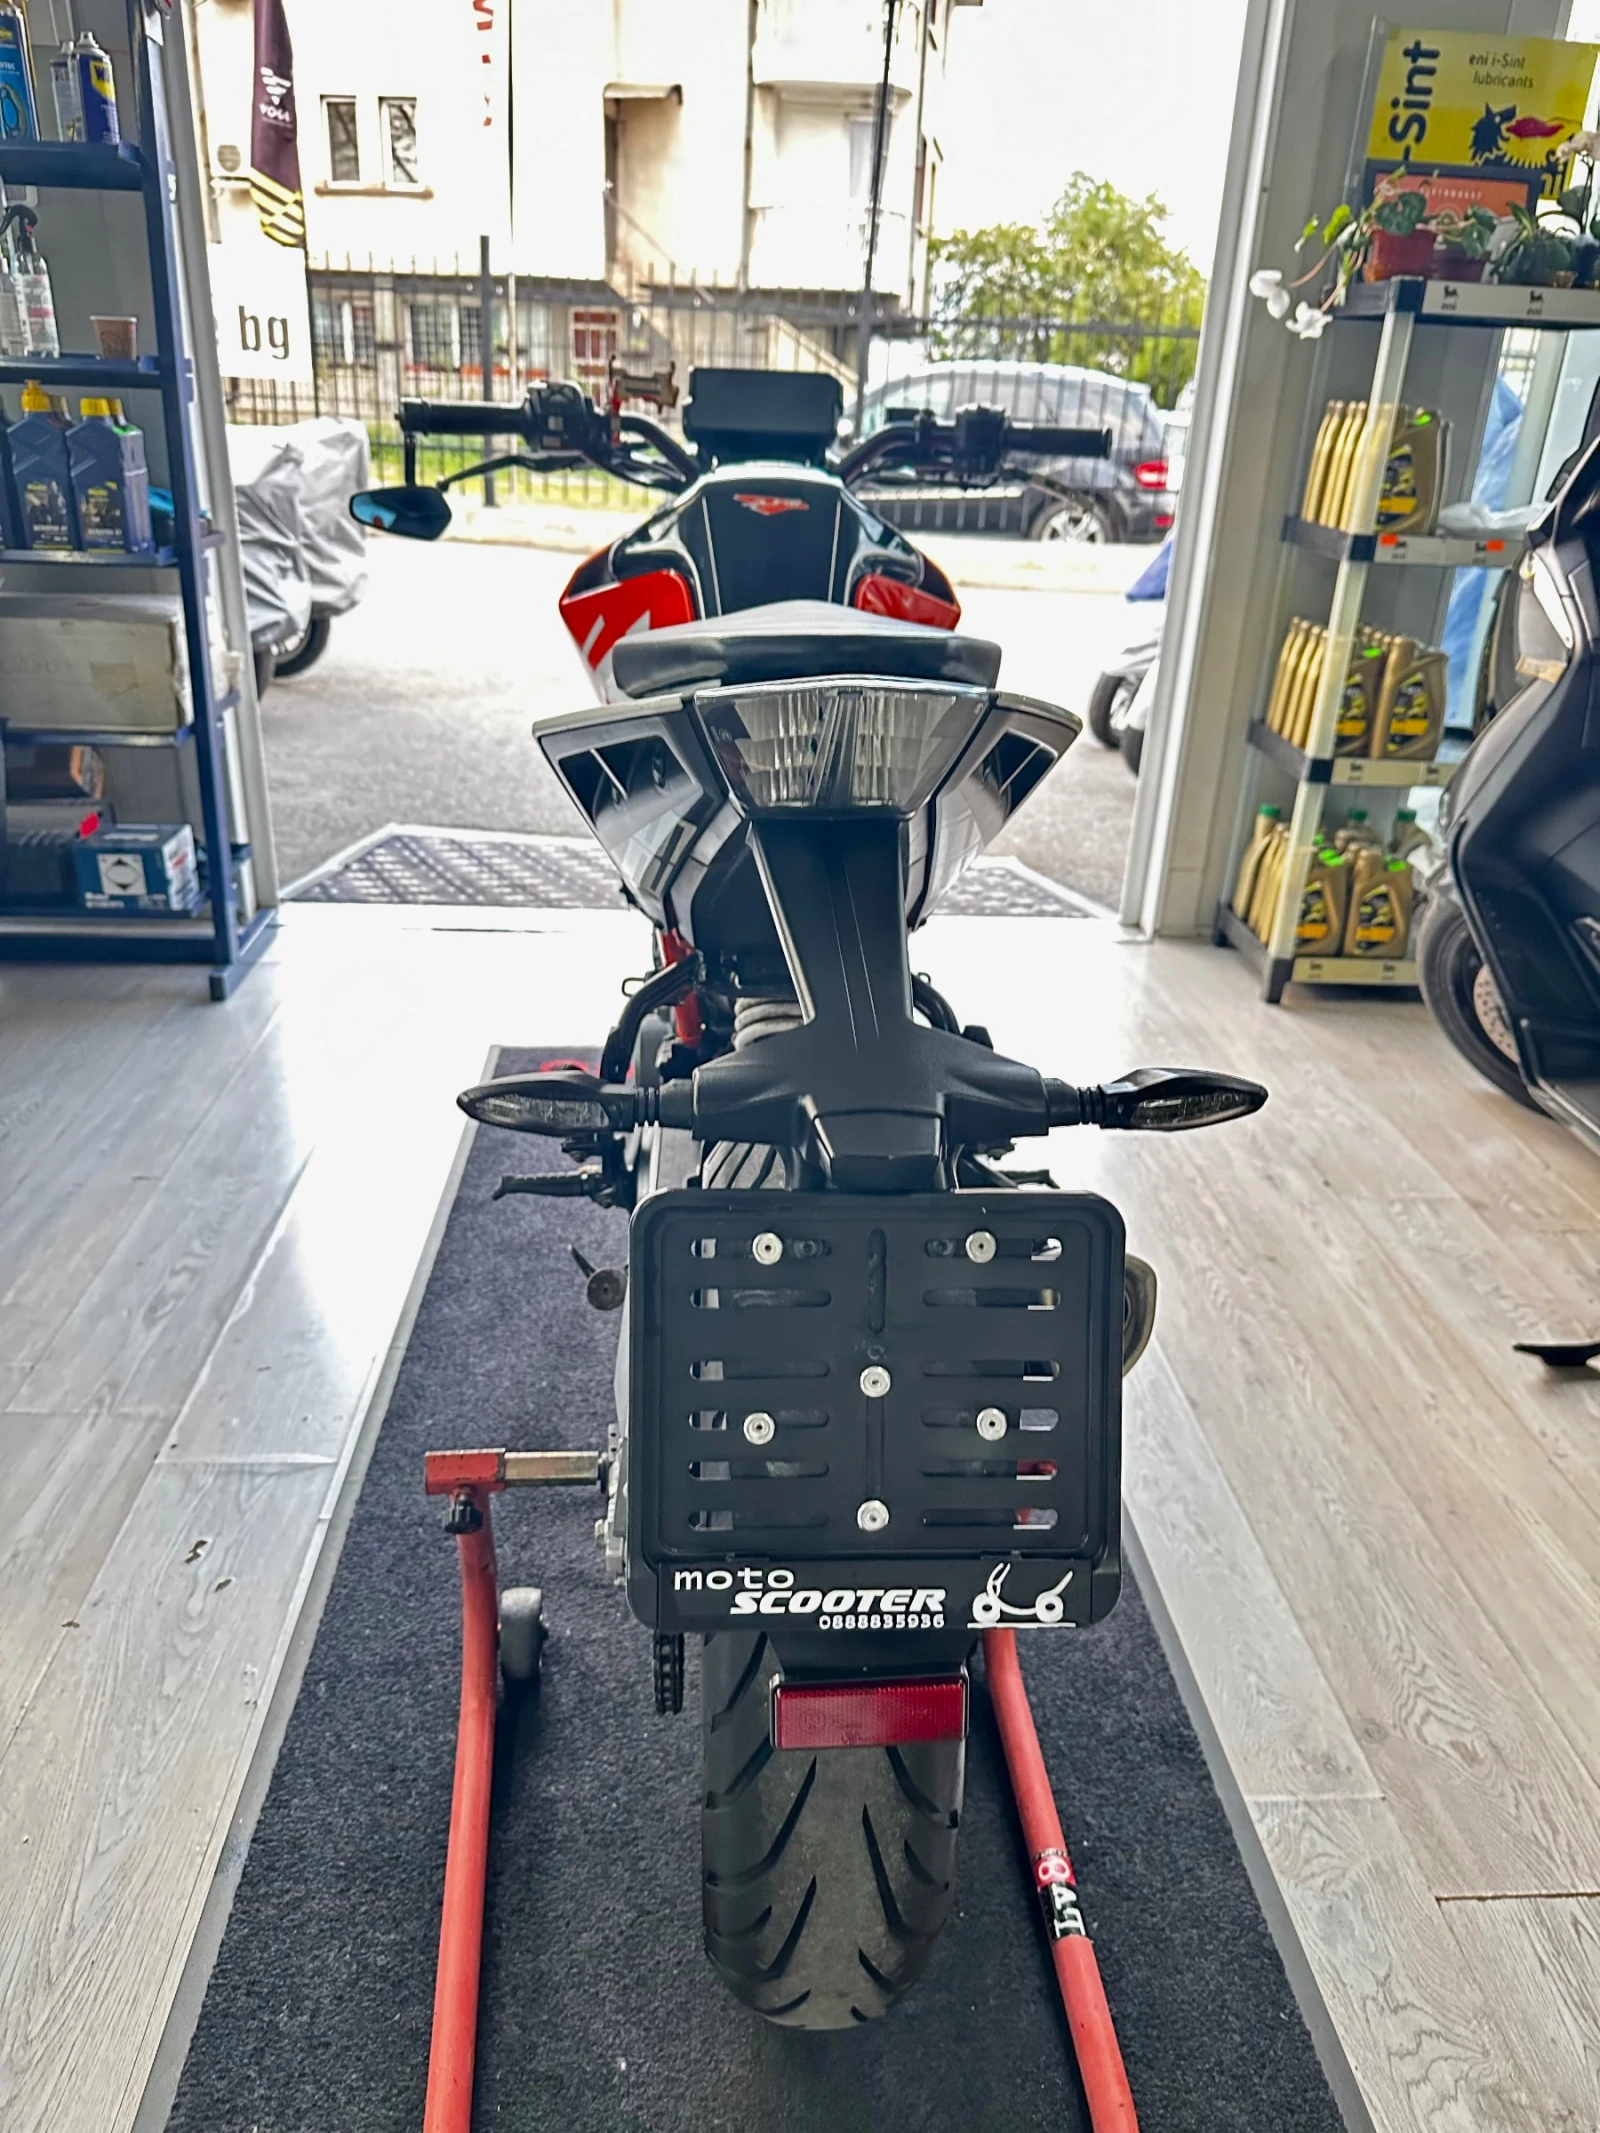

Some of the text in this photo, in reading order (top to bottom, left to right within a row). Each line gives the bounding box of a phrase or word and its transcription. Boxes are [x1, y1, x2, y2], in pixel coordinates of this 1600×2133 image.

[1469, 50, 1526, 69] eni i-Sint
[1473, 69, 1534, 89] lubricants
[1388, 39, 1440, 161] -Sint
[238, 305, 289, 360] bg
[674, 1567, 794, 1590] moto
[730, 1588, 947, 1615] SCOOTER
